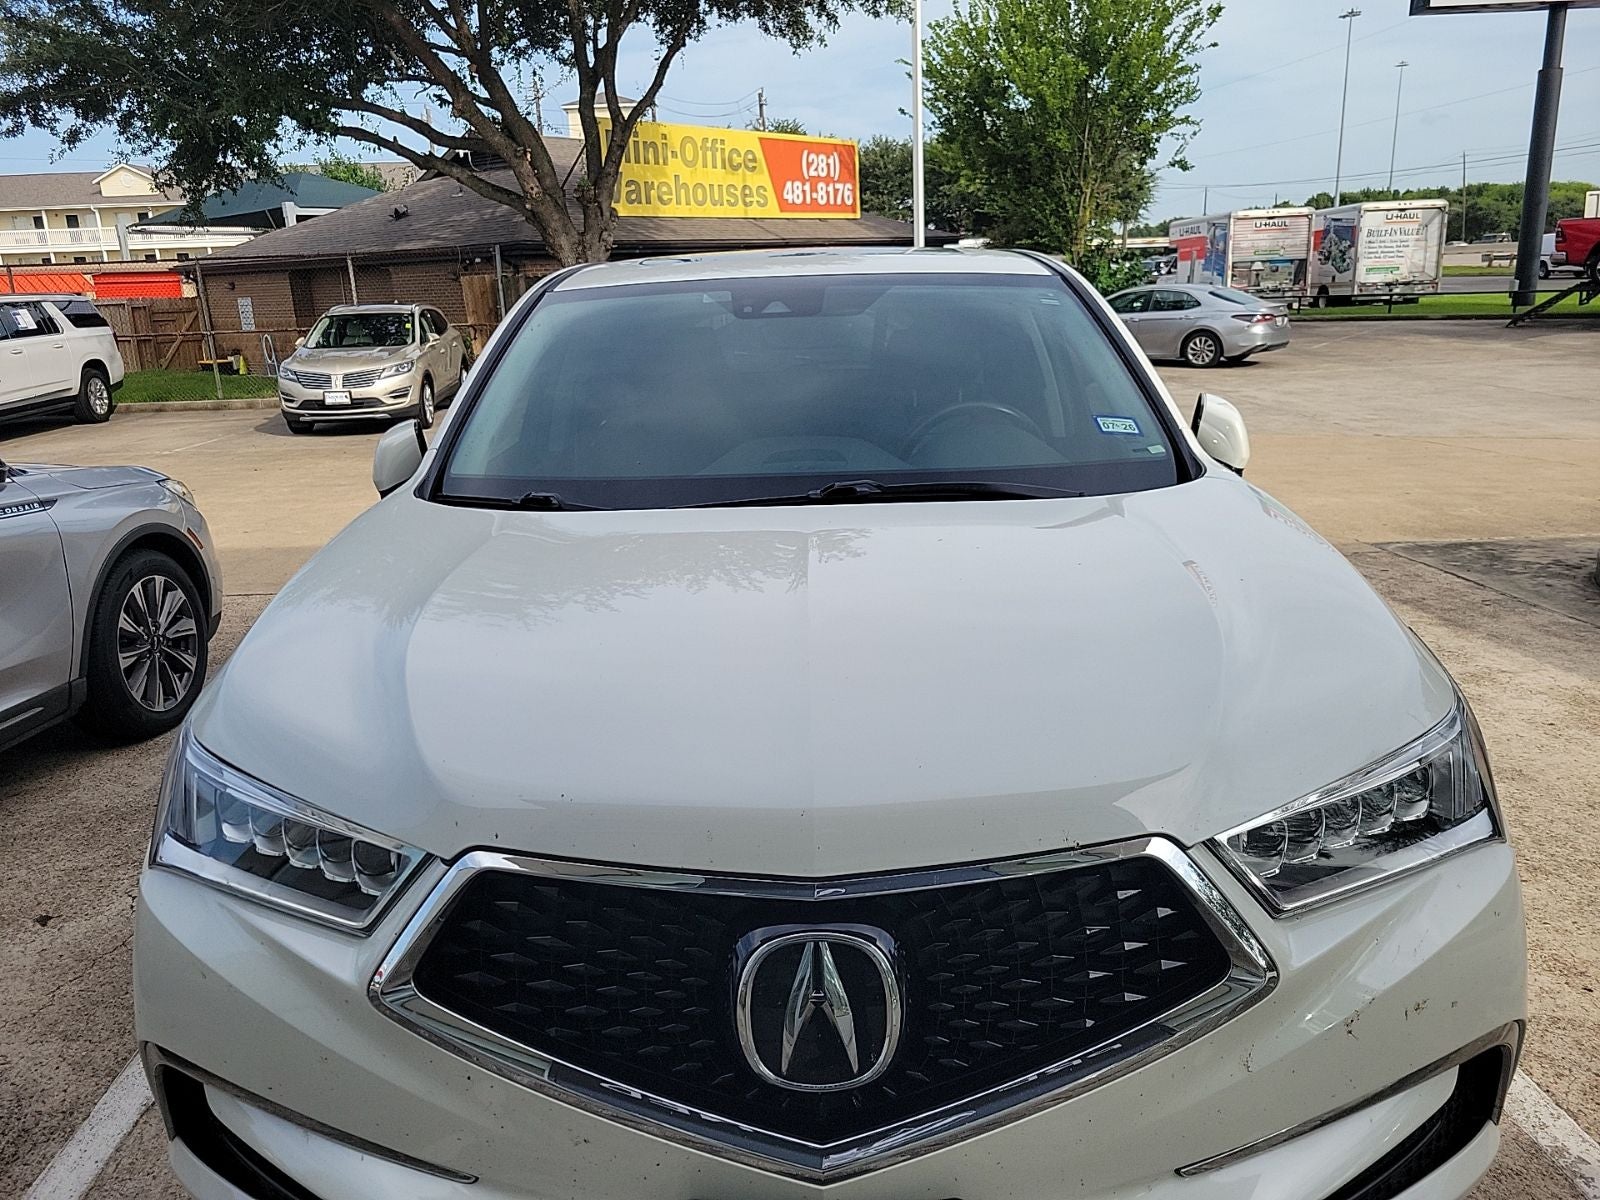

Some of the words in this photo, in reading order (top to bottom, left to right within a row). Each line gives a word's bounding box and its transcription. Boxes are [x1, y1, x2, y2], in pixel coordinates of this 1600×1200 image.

[801, 149, 840, 181] (281)
[783, 180, 853, 206] 481-8176
[1254, 220, 1288, 228] U-HAUL
